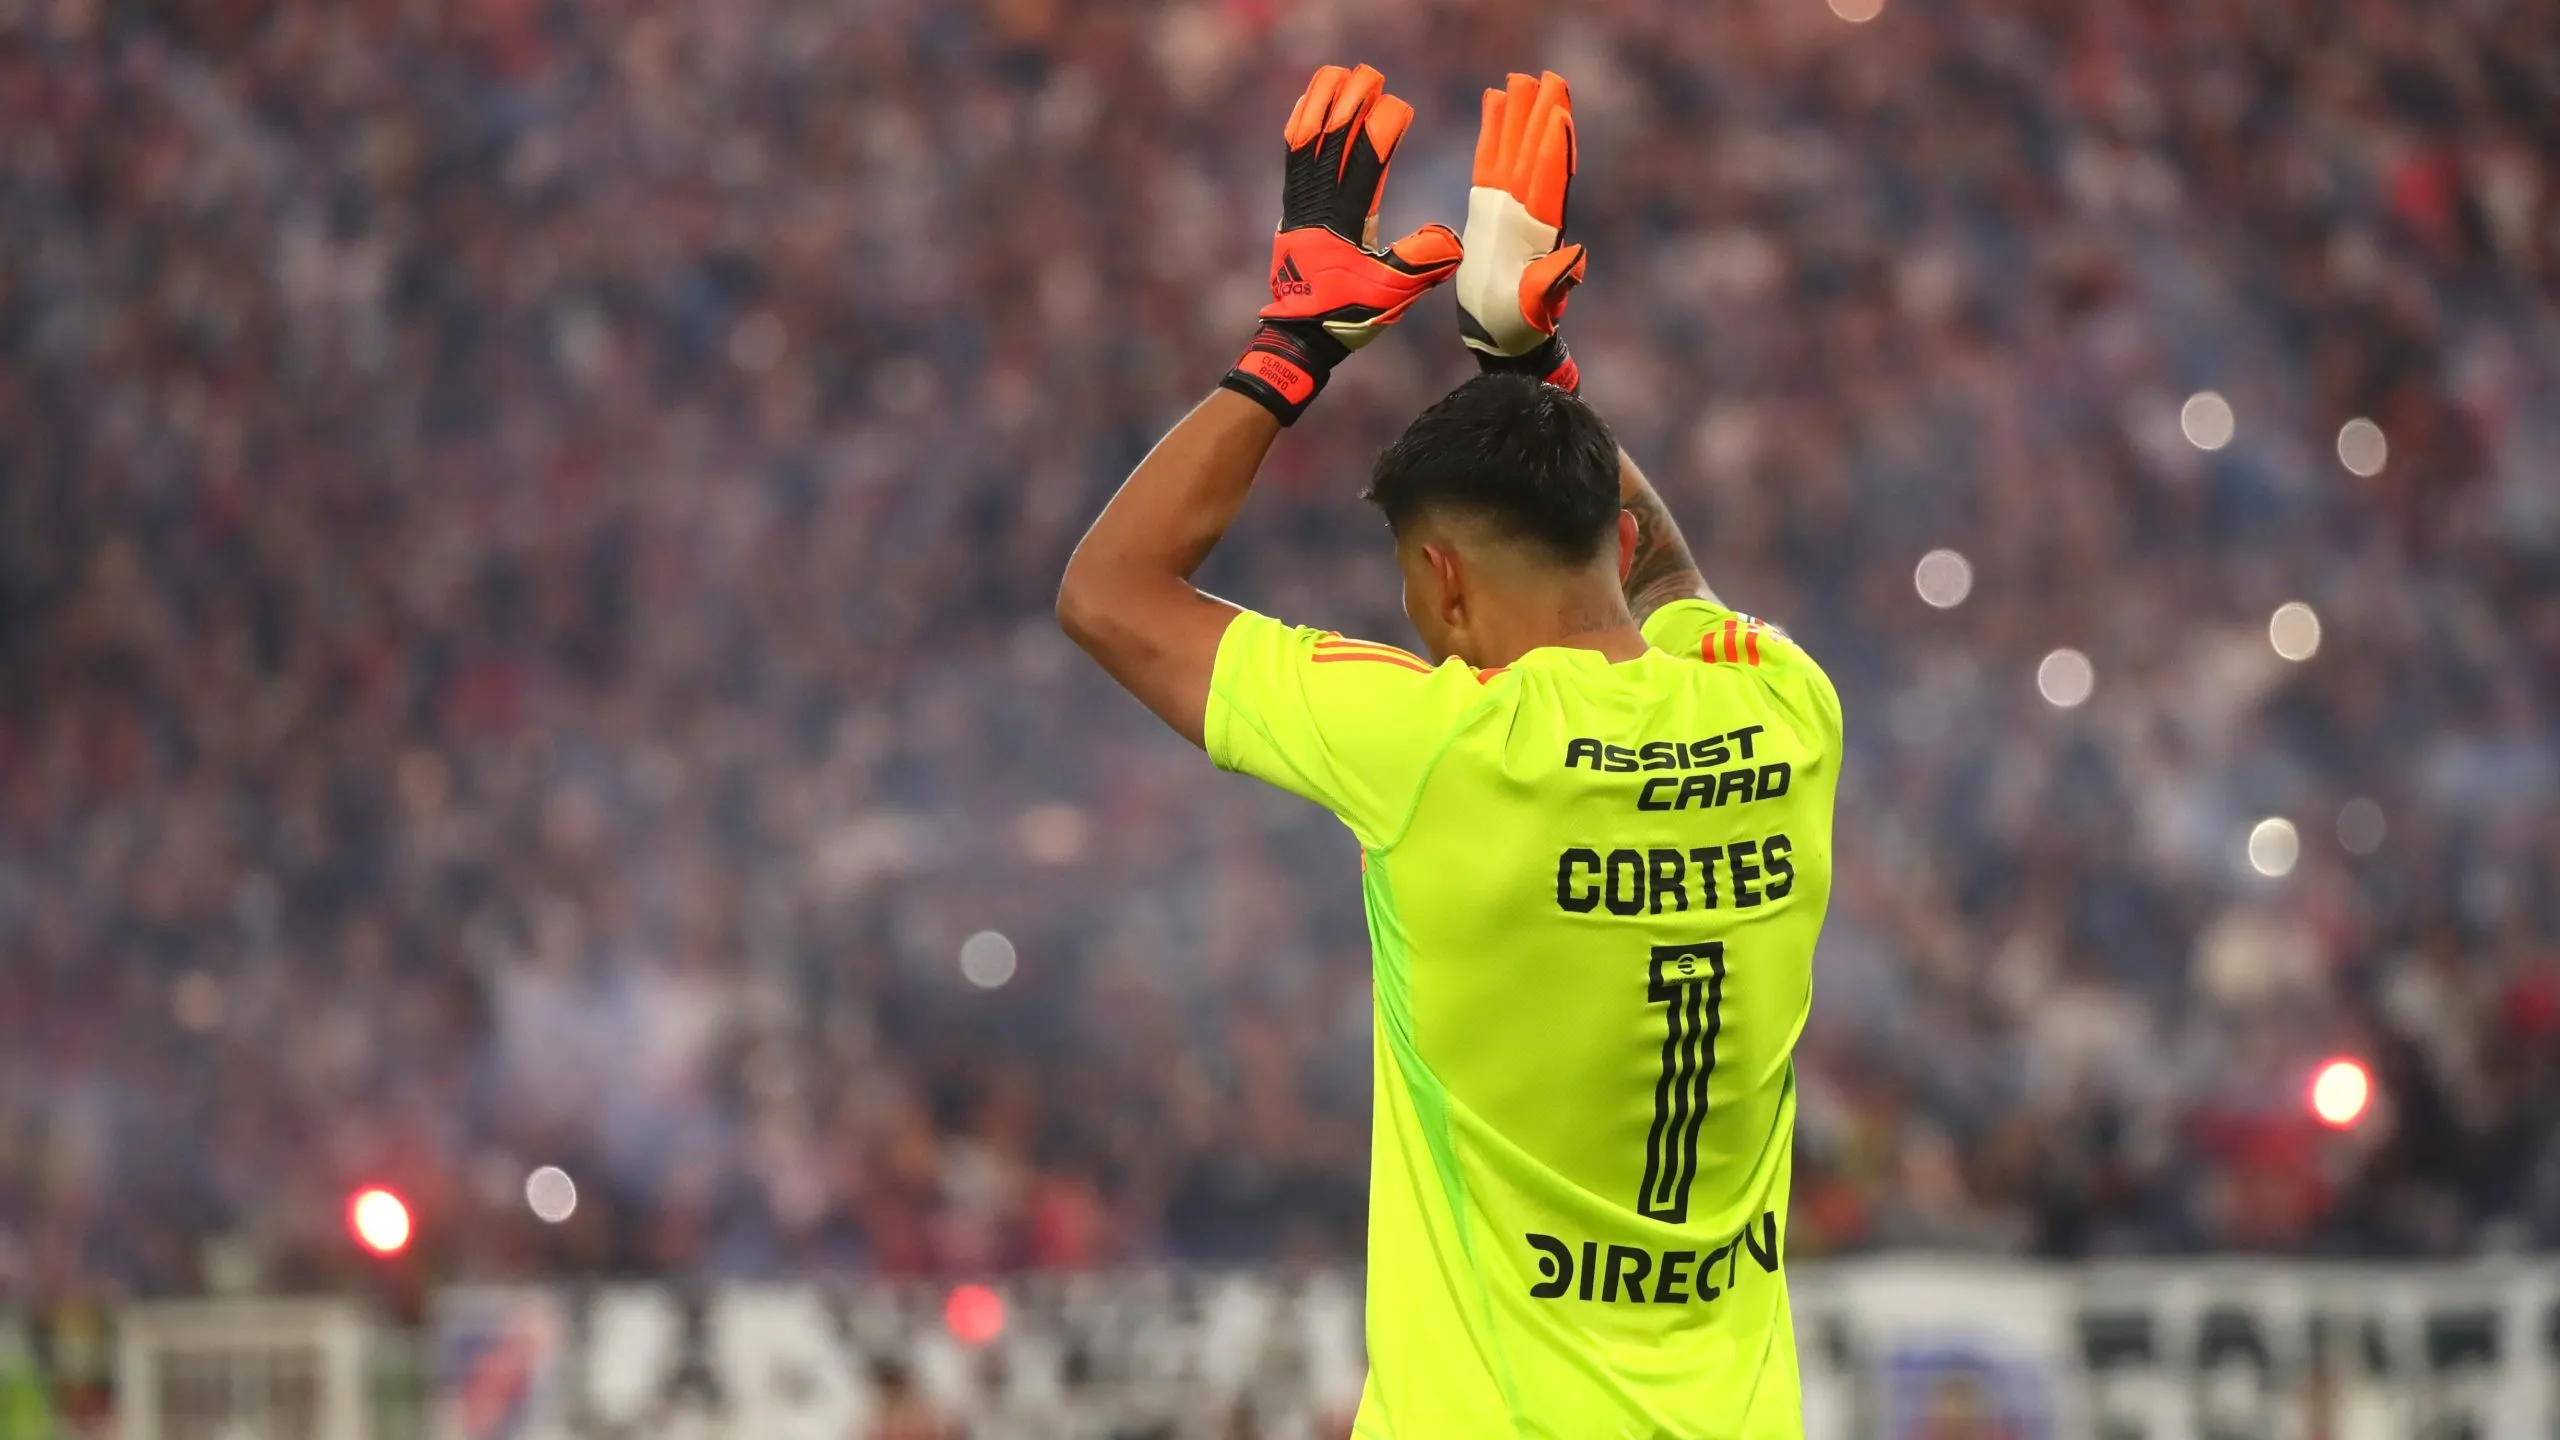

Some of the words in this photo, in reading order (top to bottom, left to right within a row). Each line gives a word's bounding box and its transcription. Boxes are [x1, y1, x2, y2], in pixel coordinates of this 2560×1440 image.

[1259, 366, 1289, 391] BRAVO
[1262, 355, 1299, 385] CLAUDIO
[1564, 725, 1764, 773] ASSIST
[1637, 762, 1791, 811] CARD
[1557, 833, 1795, 916] CORTES
[1637, 941, 1726, 1225] 1
